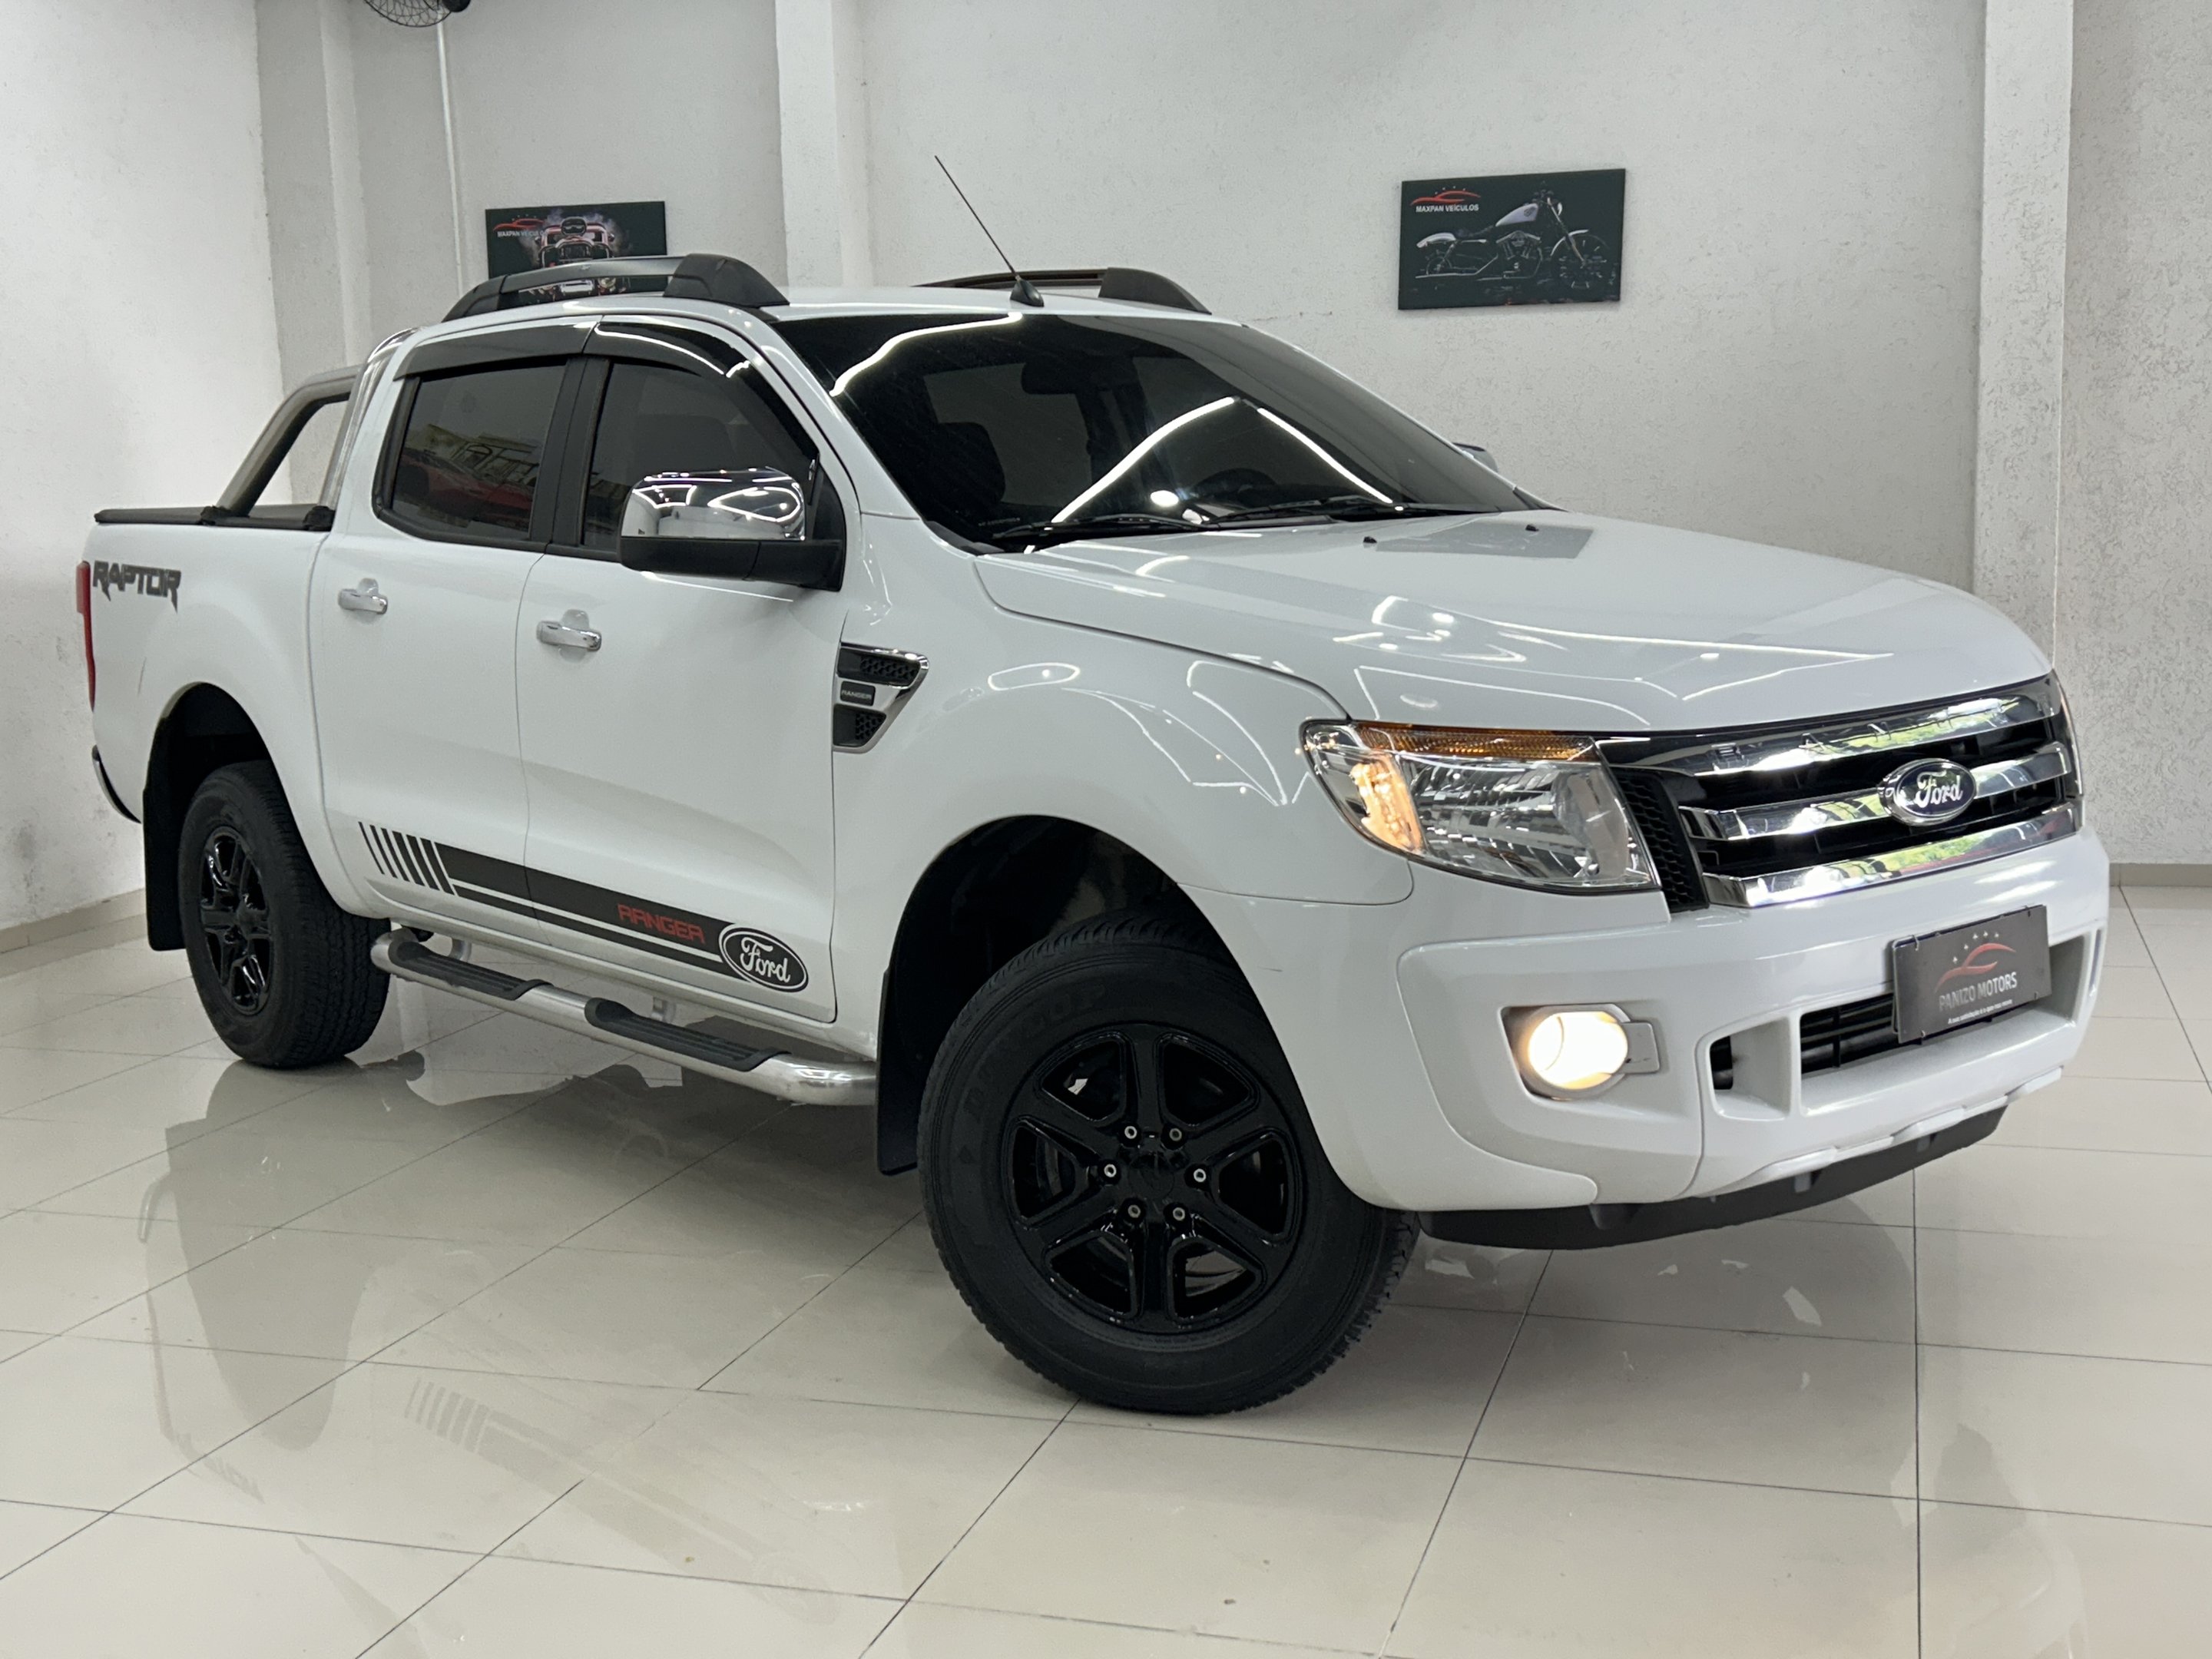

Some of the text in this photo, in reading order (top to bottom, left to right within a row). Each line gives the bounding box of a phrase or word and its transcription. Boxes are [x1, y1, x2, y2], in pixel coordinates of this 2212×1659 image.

[92, 560, 181, 614] RAPTOR
[1913, 770, 1963, 808] Ford
[618, 903, 706, 944] RANGER
[740, 937, 790, 983] Ford
[1939, 985, 1976, 1012] PANIZO
[1977, 972, 2018, 999] MOTORS
